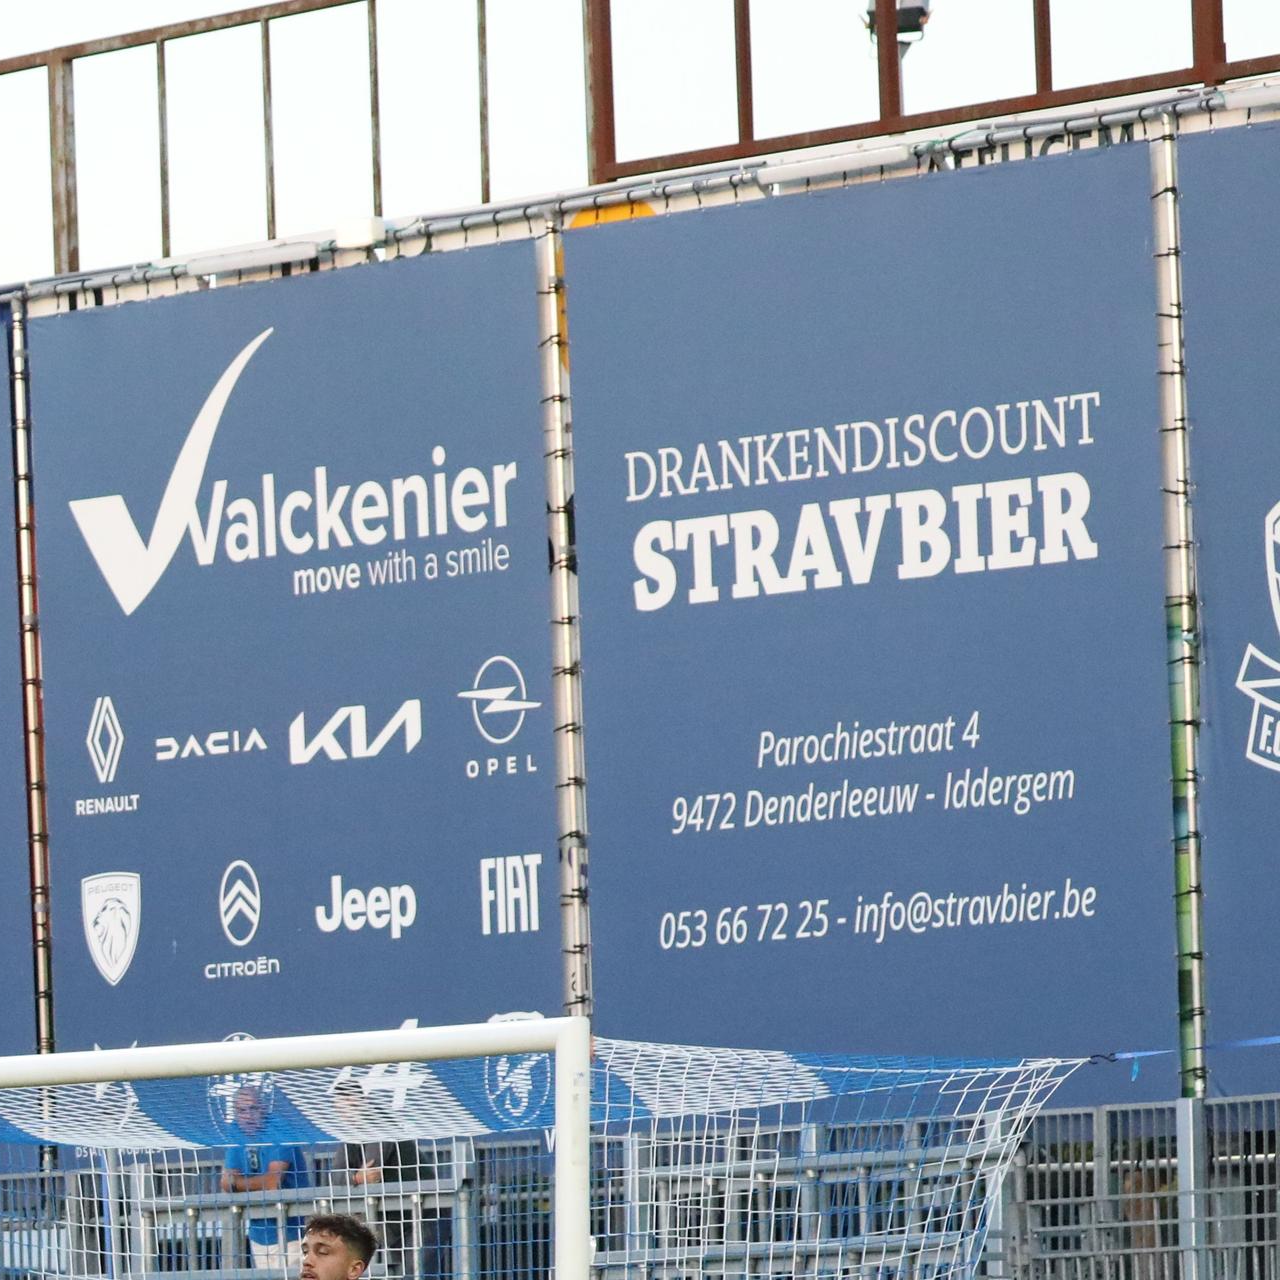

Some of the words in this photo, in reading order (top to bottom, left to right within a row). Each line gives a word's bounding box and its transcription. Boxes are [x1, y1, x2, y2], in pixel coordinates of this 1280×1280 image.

[624, 391, 1101, 502] DRANKENDISCOUNT
[184, 446, 518, 566] Valckenier
[293, 559, 361, 596] move
[367, 553, 418, 589] with
[424, 555, 438, 579] a
[446, 539, 510, 578] smile
[632, 471, 1099, 612] STRAVBIER
[156, 728, 268, 761] DACIA
[289, 699, 421, 766] KIA
[757, 719, 955, 769] Parochiestraat
[962, 712, 981, 749] 4
[1258, 714, 1280, 758] F.
[466, 754, 538, 779] OPEL
[75, 794, 139, 816] RENAULT
[671, 793, 737, 835] 9472
[745, 778, 917, 829] Denderleeuw
[944, 768, 1075, 814] Iddergem
[315, 875, 417, 939] Jeep
[479, 854, 542, 936] FIAT
[659, 906, 707, 950] 053
[716, 904, 748, 946] 66
[756, 902, 789, 943] 72
[796, 899, 830, 940] 25
[855, 879, 1098, 943] info@stravbier.be
